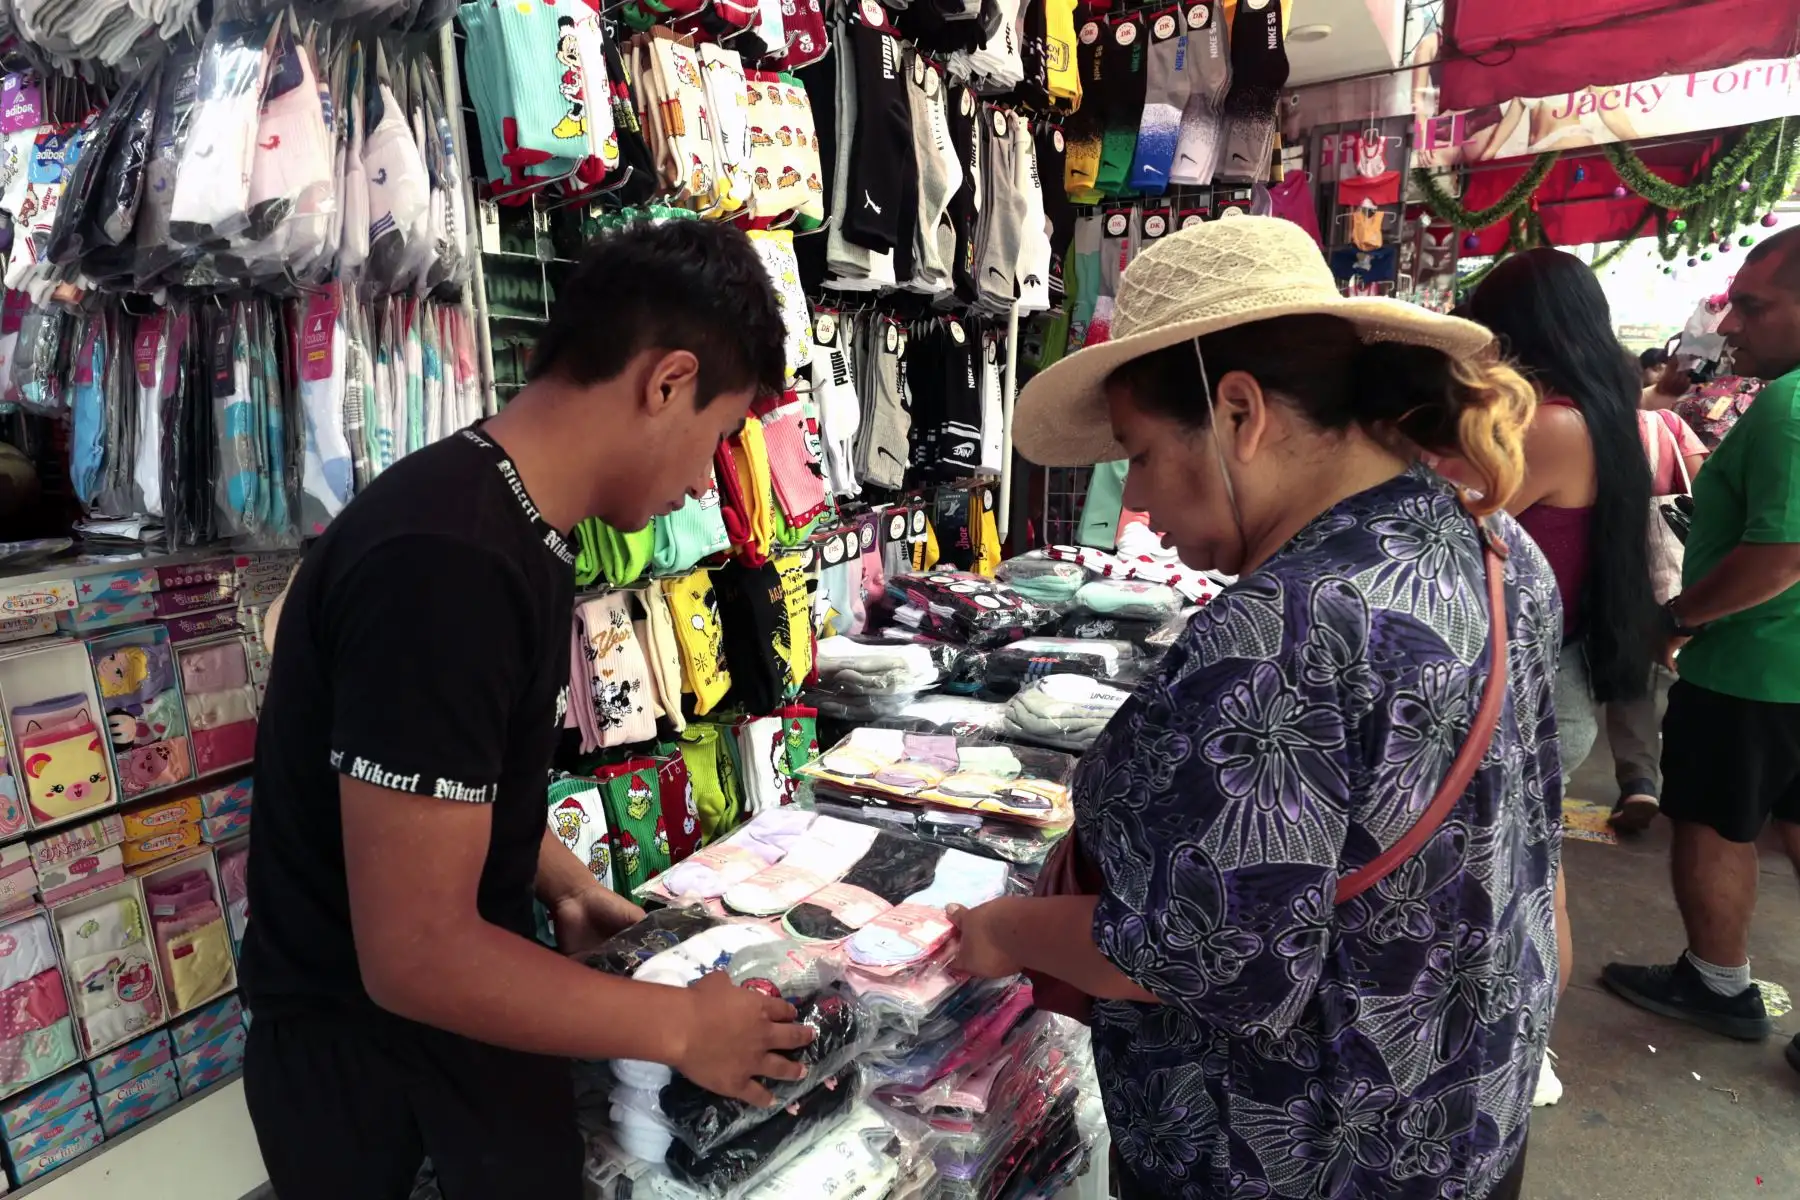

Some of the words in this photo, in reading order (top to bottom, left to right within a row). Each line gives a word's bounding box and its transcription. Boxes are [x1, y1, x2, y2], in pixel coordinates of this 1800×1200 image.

[1267, 11, 1276, 24] SB
[1210, 35, 1218, 58] NIKE
[1267, 26, 1277, 50] NIKE
[881, 34, 895, 79] PUMA
[1175, 48, 1185, 71] NIKE
[1552, 80, 1671, 120] Jacky
[830, 350, 848, 387] PUMA
[968, 367, 976, 389] NIKE
[953, 446, 973, 458] NIKE
[349, 756, 421, 793] Nikcerf
